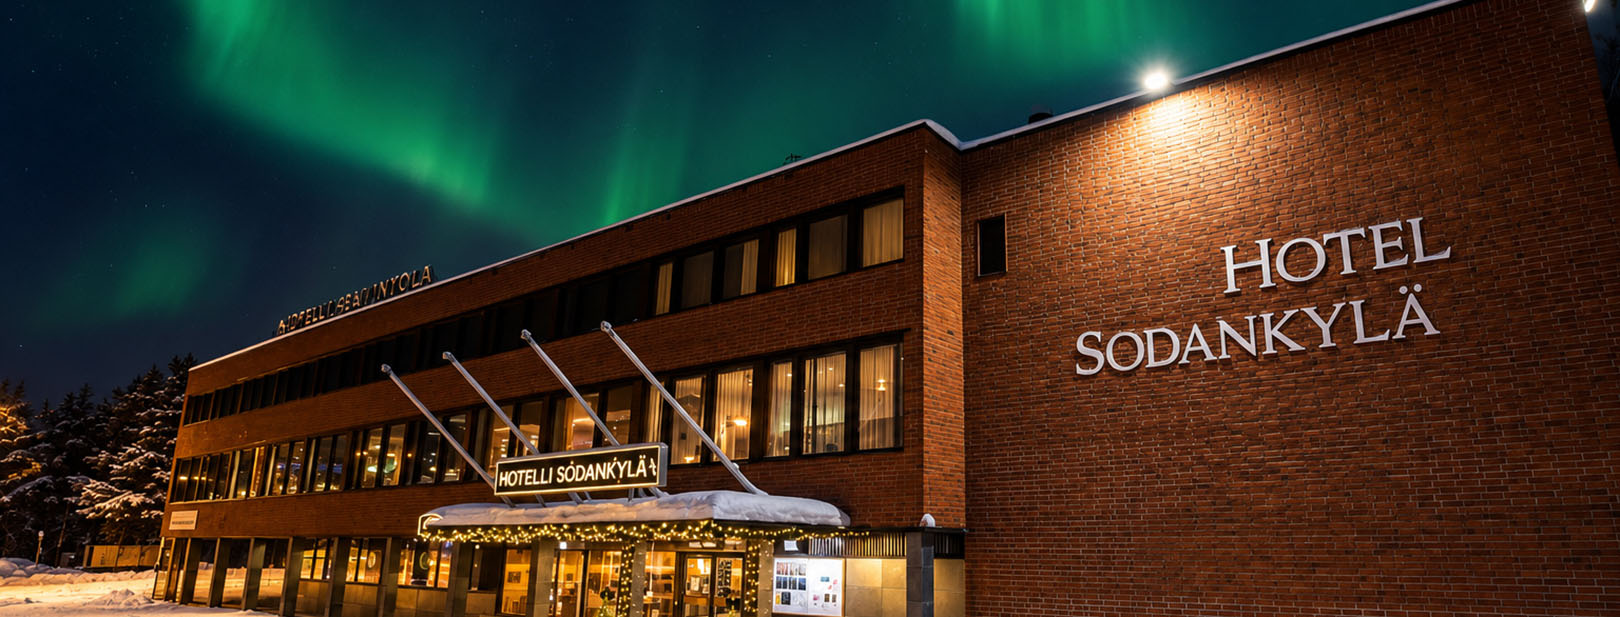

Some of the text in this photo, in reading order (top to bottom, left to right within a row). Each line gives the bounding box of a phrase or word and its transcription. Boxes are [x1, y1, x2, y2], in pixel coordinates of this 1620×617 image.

[1220, 216, 1452, 295] HOTEL
[1075, 284, 1441, 376] SODANKYLÄ
[499, 467, 553, 487] HOTELLI
